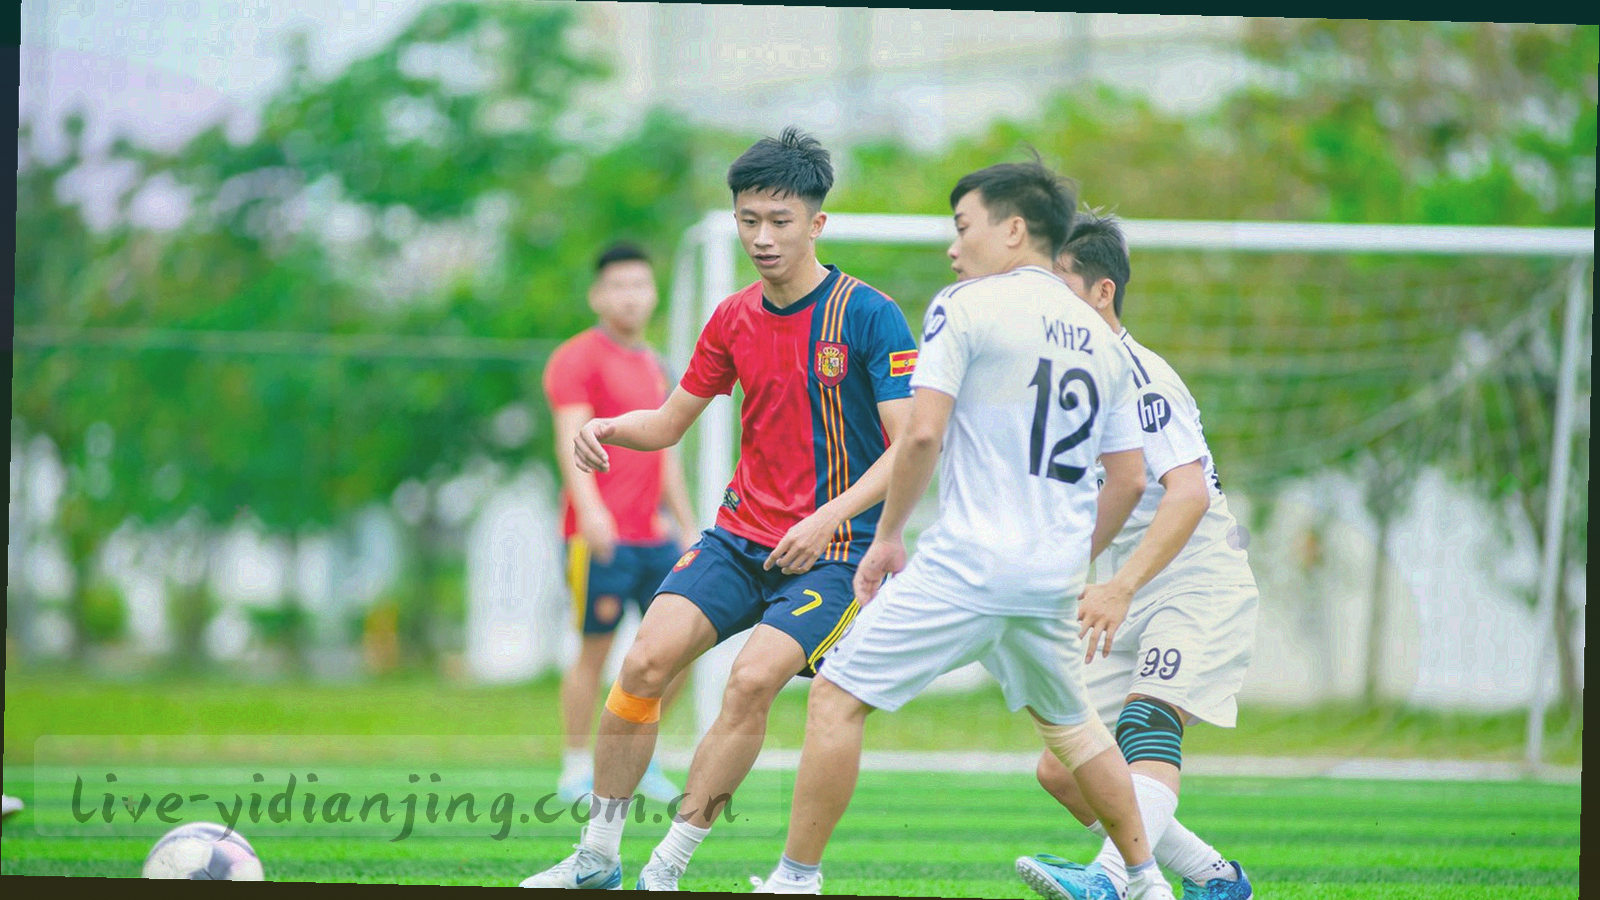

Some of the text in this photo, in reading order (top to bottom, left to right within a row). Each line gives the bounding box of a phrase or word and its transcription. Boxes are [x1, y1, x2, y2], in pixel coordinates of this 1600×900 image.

[1042, 316, 1094, 356] WH2
[1027, 357, 1099, 485] 12
[1138, 393, 1171, 433] hp
[791, 589, 823, 617] 7
[1140, 647, 1182, 680] 99
